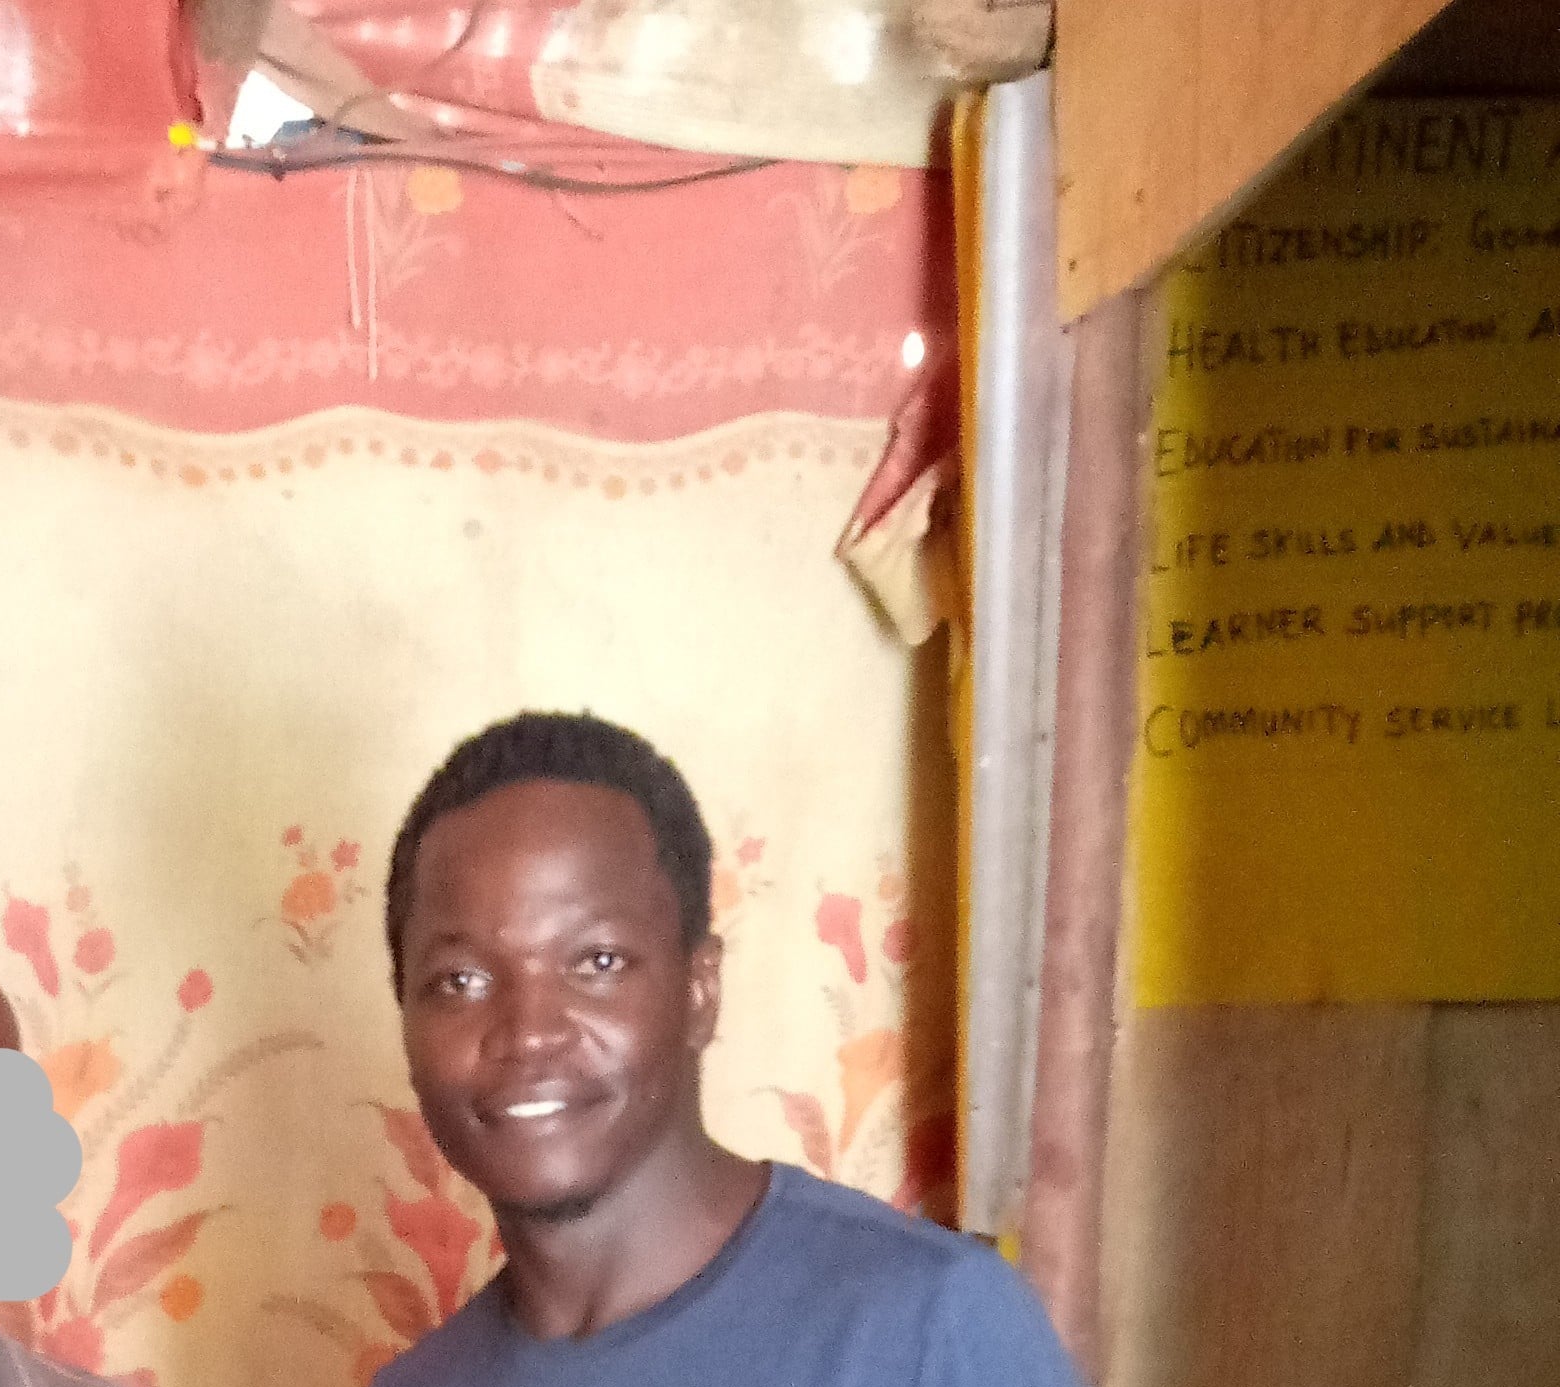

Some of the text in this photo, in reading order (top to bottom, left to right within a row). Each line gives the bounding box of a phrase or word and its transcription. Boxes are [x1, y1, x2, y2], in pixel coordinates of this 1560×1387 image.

[1301, 105, 1521, 178] TINENT
[1168, 320, 1320, 375] HEALTH
[1156, 427, 1330, 477] EDUCATION
[1345, 424, 1402, 454] FOR
[1247, 527, 1357, 560] SKILLS
[1371, 520, 1436, 552] AND
[1146, 606, 1326, 657] LEARNER
[1345, 600, 1496, 639] SUPPORT
[1145, 704, 1362, 758] COMMUNITY
[1384, 702, 1522, 740] SERVICE
